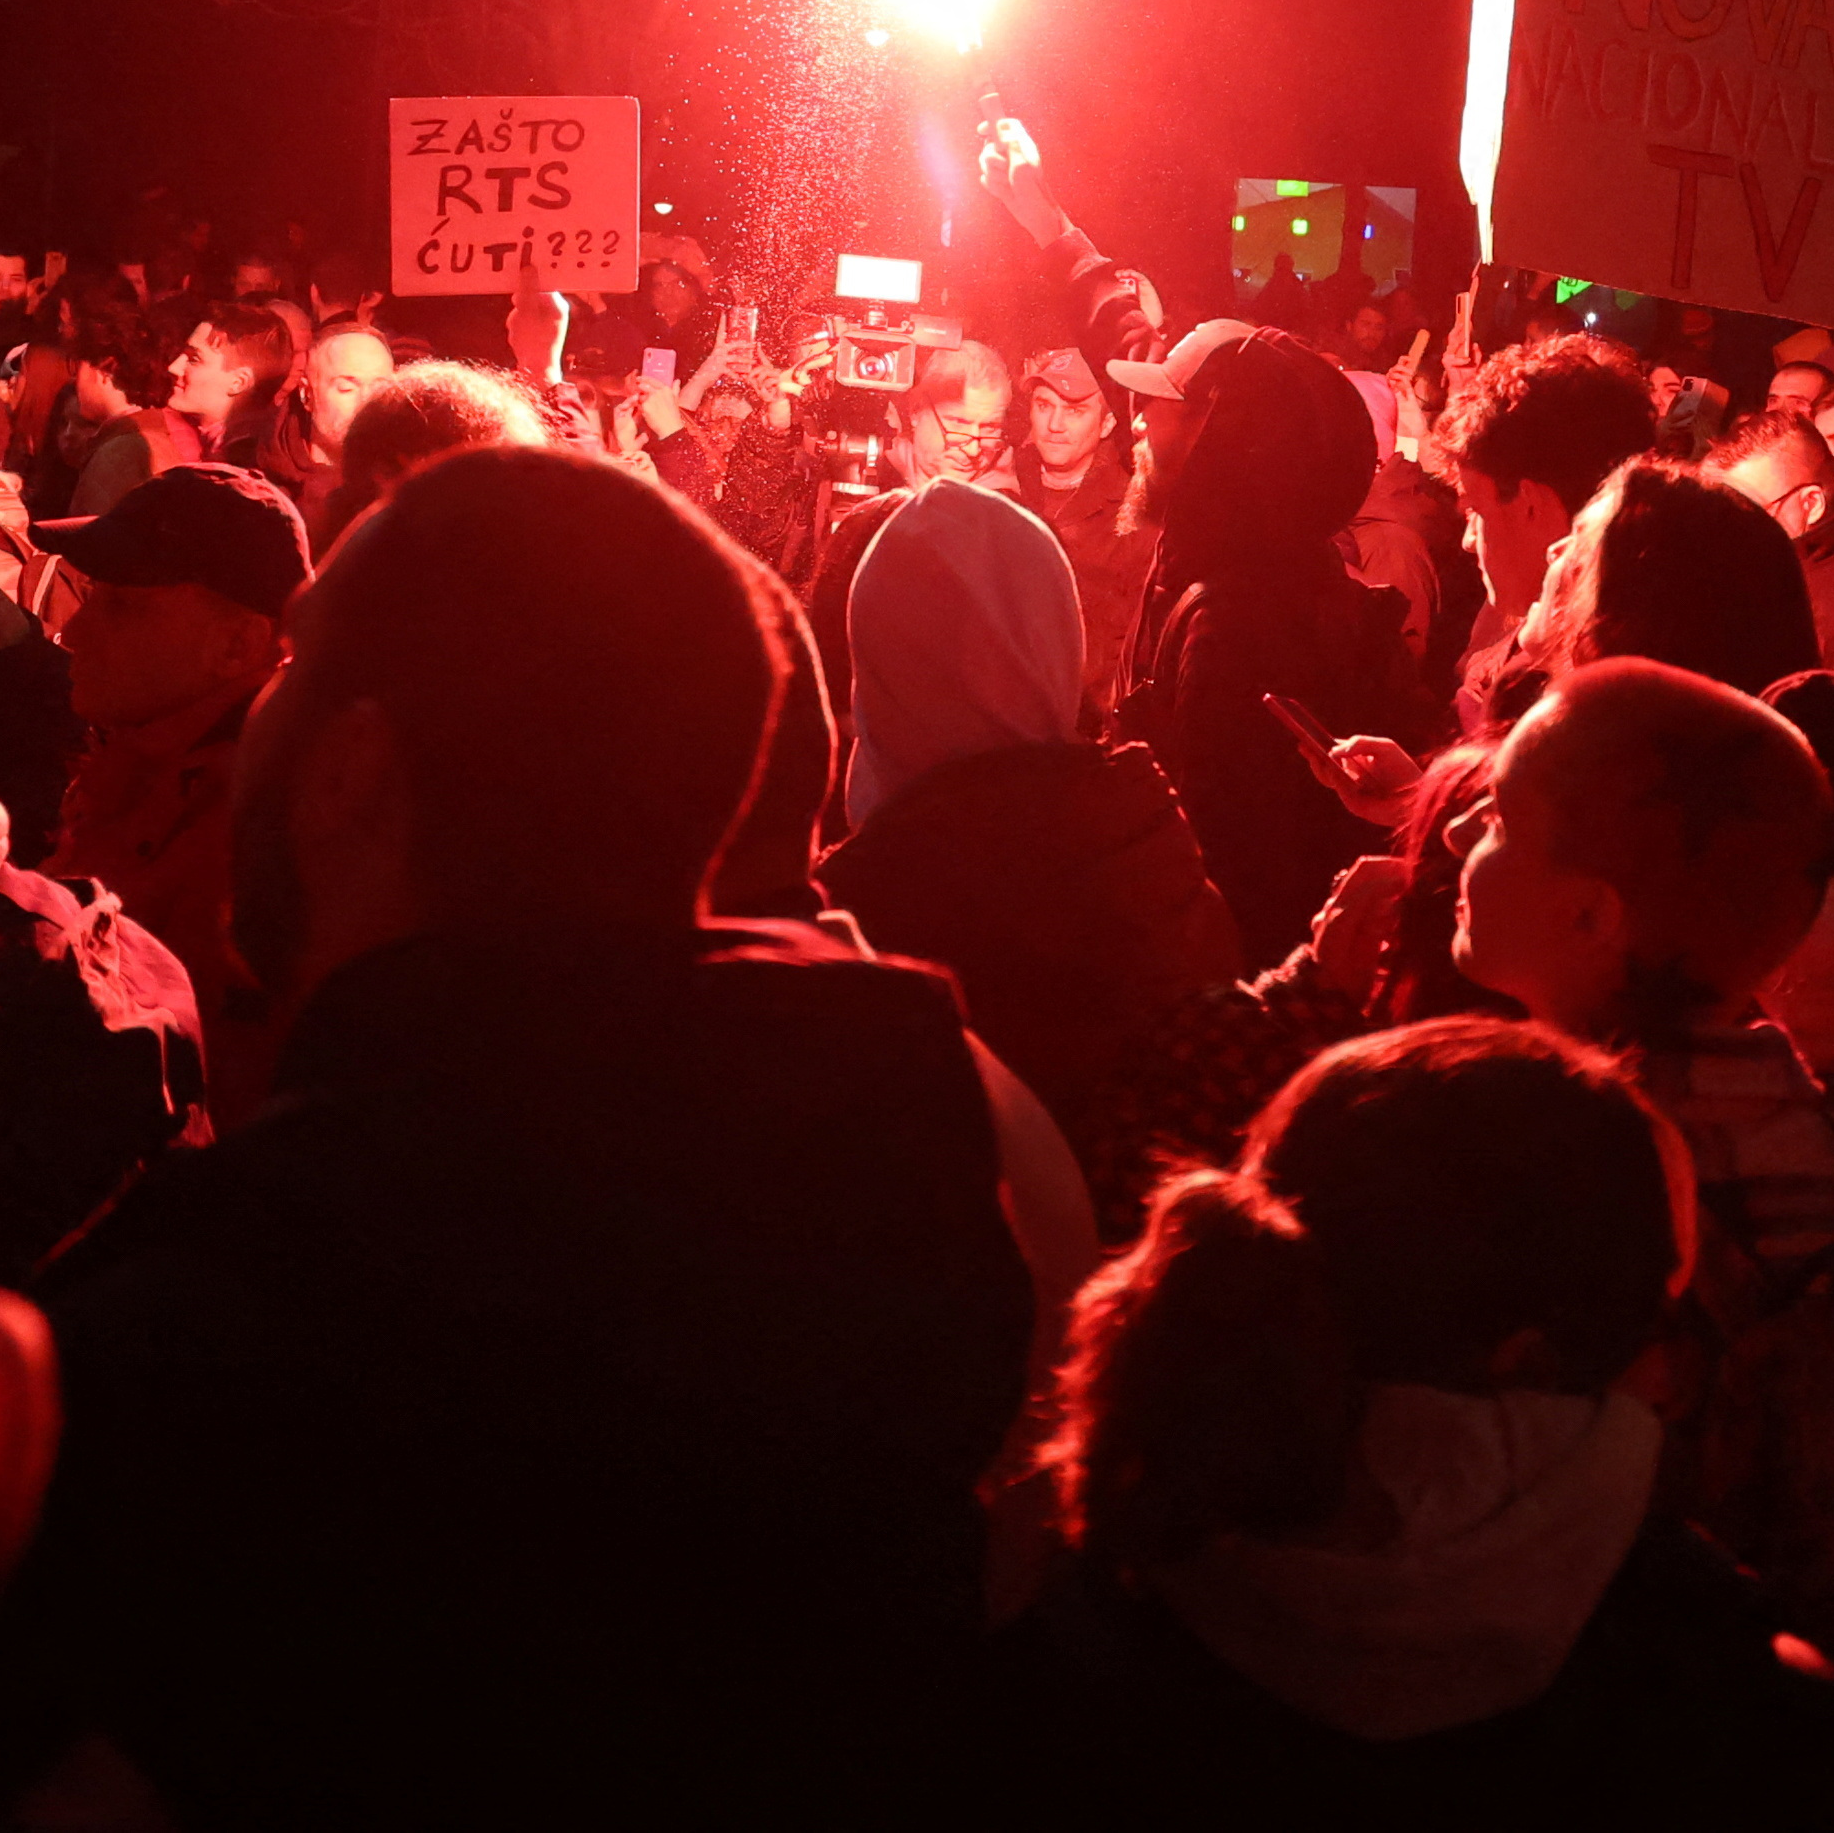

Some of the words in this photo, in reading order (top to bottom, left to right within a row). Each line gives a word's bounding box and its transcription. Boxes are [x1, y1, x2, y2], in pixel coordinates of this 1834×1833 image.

[407, 108, 585, 156] ZAŠTO
[436, 161, 572, 216] RTS
[1647, 143, 1822, 303] TV
